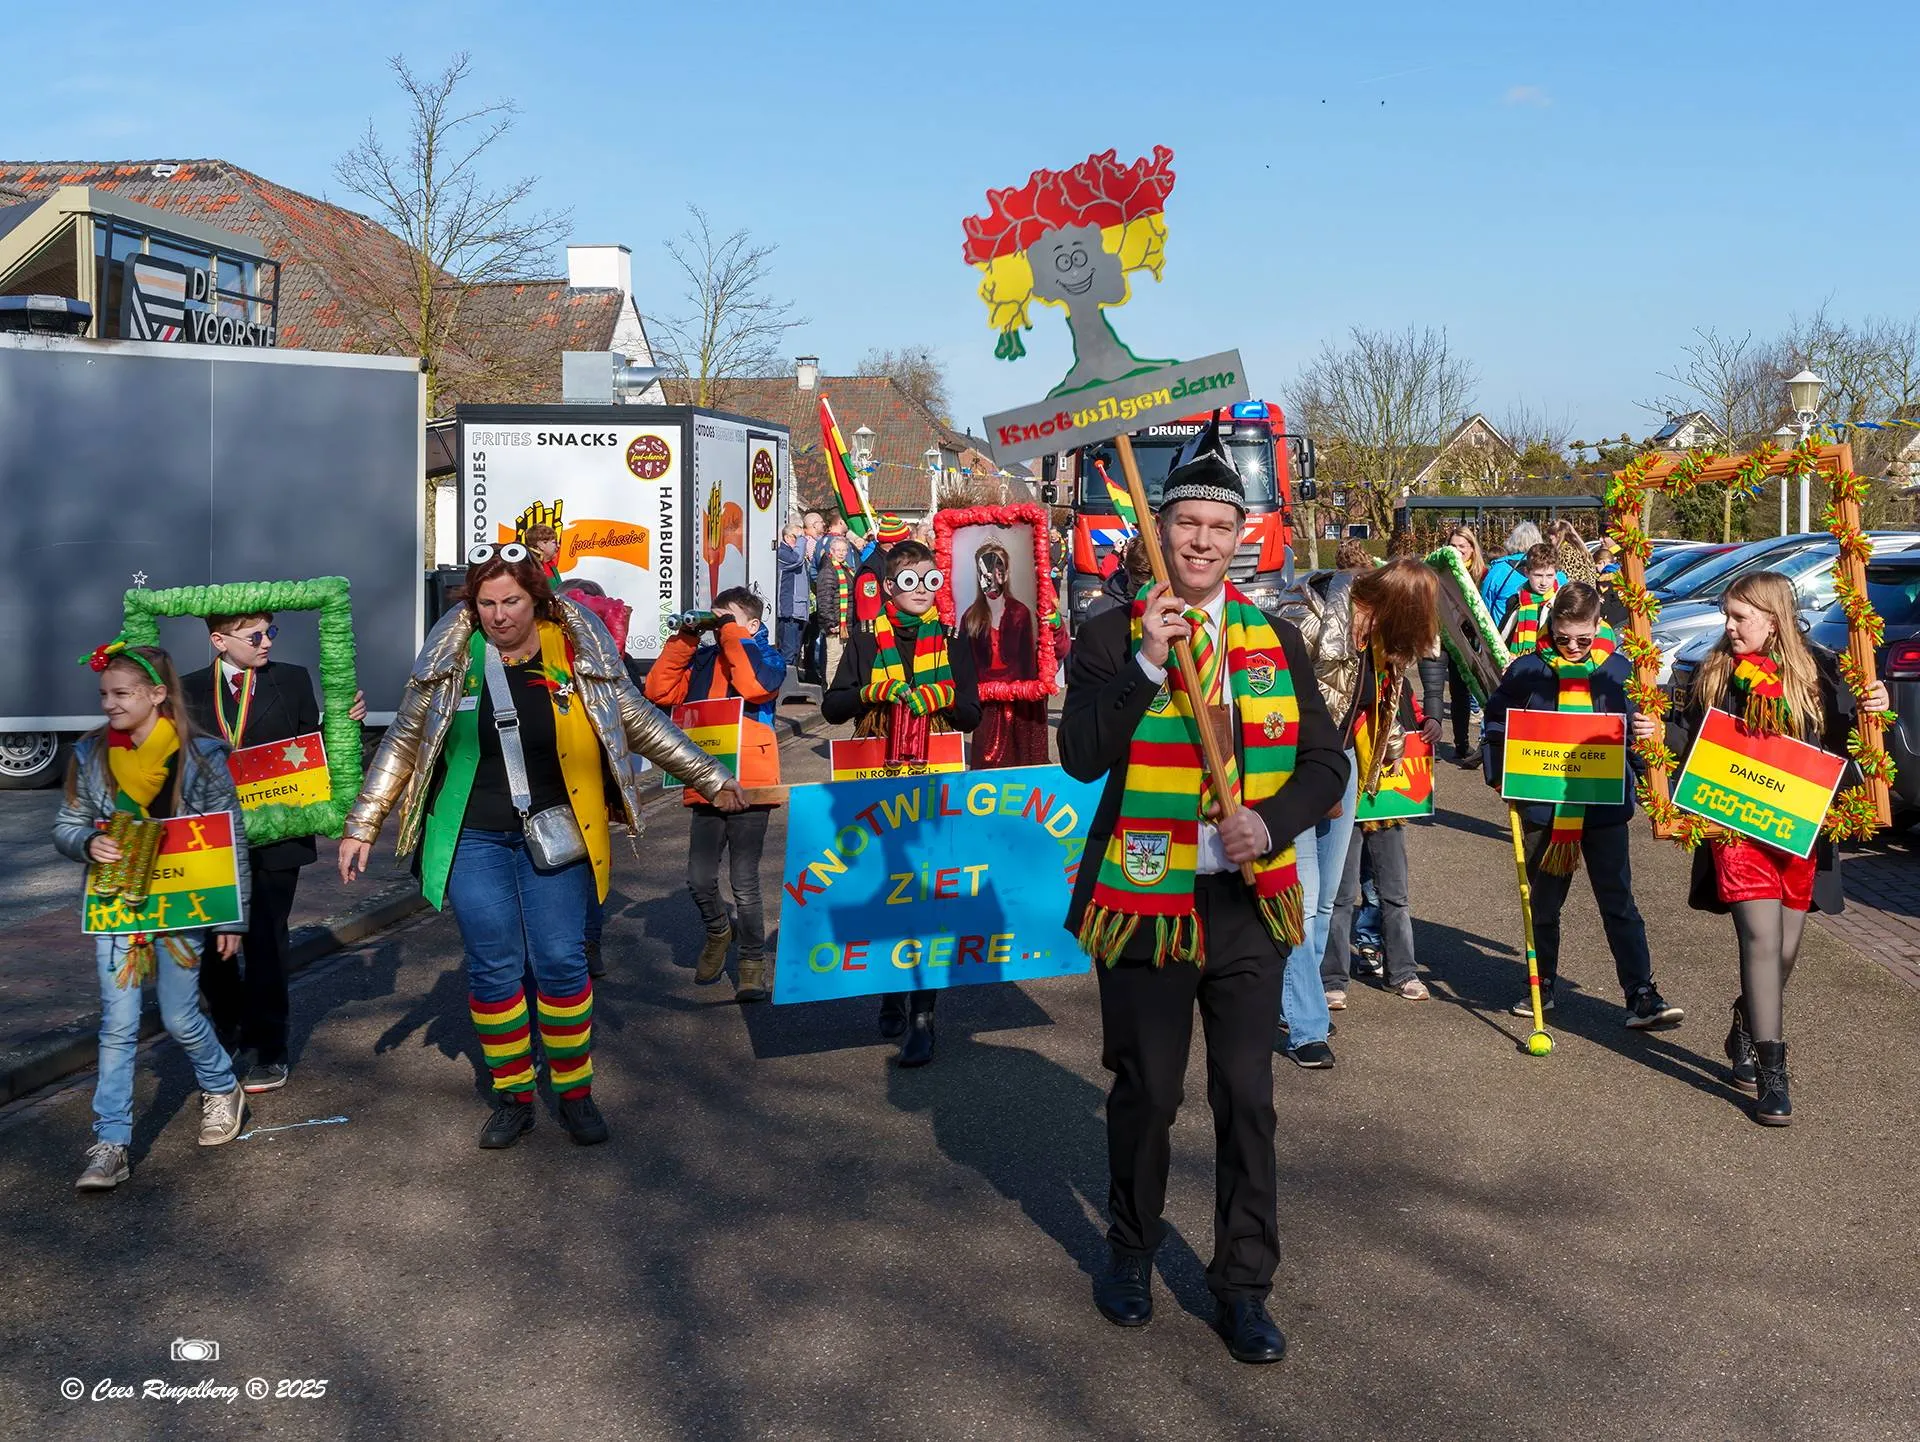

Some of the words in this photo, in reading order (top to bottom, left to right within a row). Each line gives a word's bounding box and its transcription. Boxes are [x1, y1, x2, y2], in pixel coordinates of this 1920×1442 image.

[193, 267, 218, 303] DE
[192, 310, 276, 347] VOORSTE
[996, 370, 1236, 447] Knotwilgendam
[472, 431, 533, 447] FRITES
[536, 432, 618, 447] SNACKS
[1149, 425, 1205, 437] DRUNEN
[473, 450, 488, 543] ROODJES
[568, 528, 646, 558] food-classics
[659, 486, 673, 600] HAMBURGER
[1521, 747, 1532, 757] IK
[1533, 749, 1560, 758] HEUR
[1562, 751, 1577, 760] OE
[1542, 762, 1582, 773] ZINGEN
[855, 771, 867, 779] IN
[1729, 763, 1786, 793] DANSEN
[238, 783, 299, 805] HITTEREN
[151, 866, 185, 881] SEN
[808, 940, 872, 973] OE
